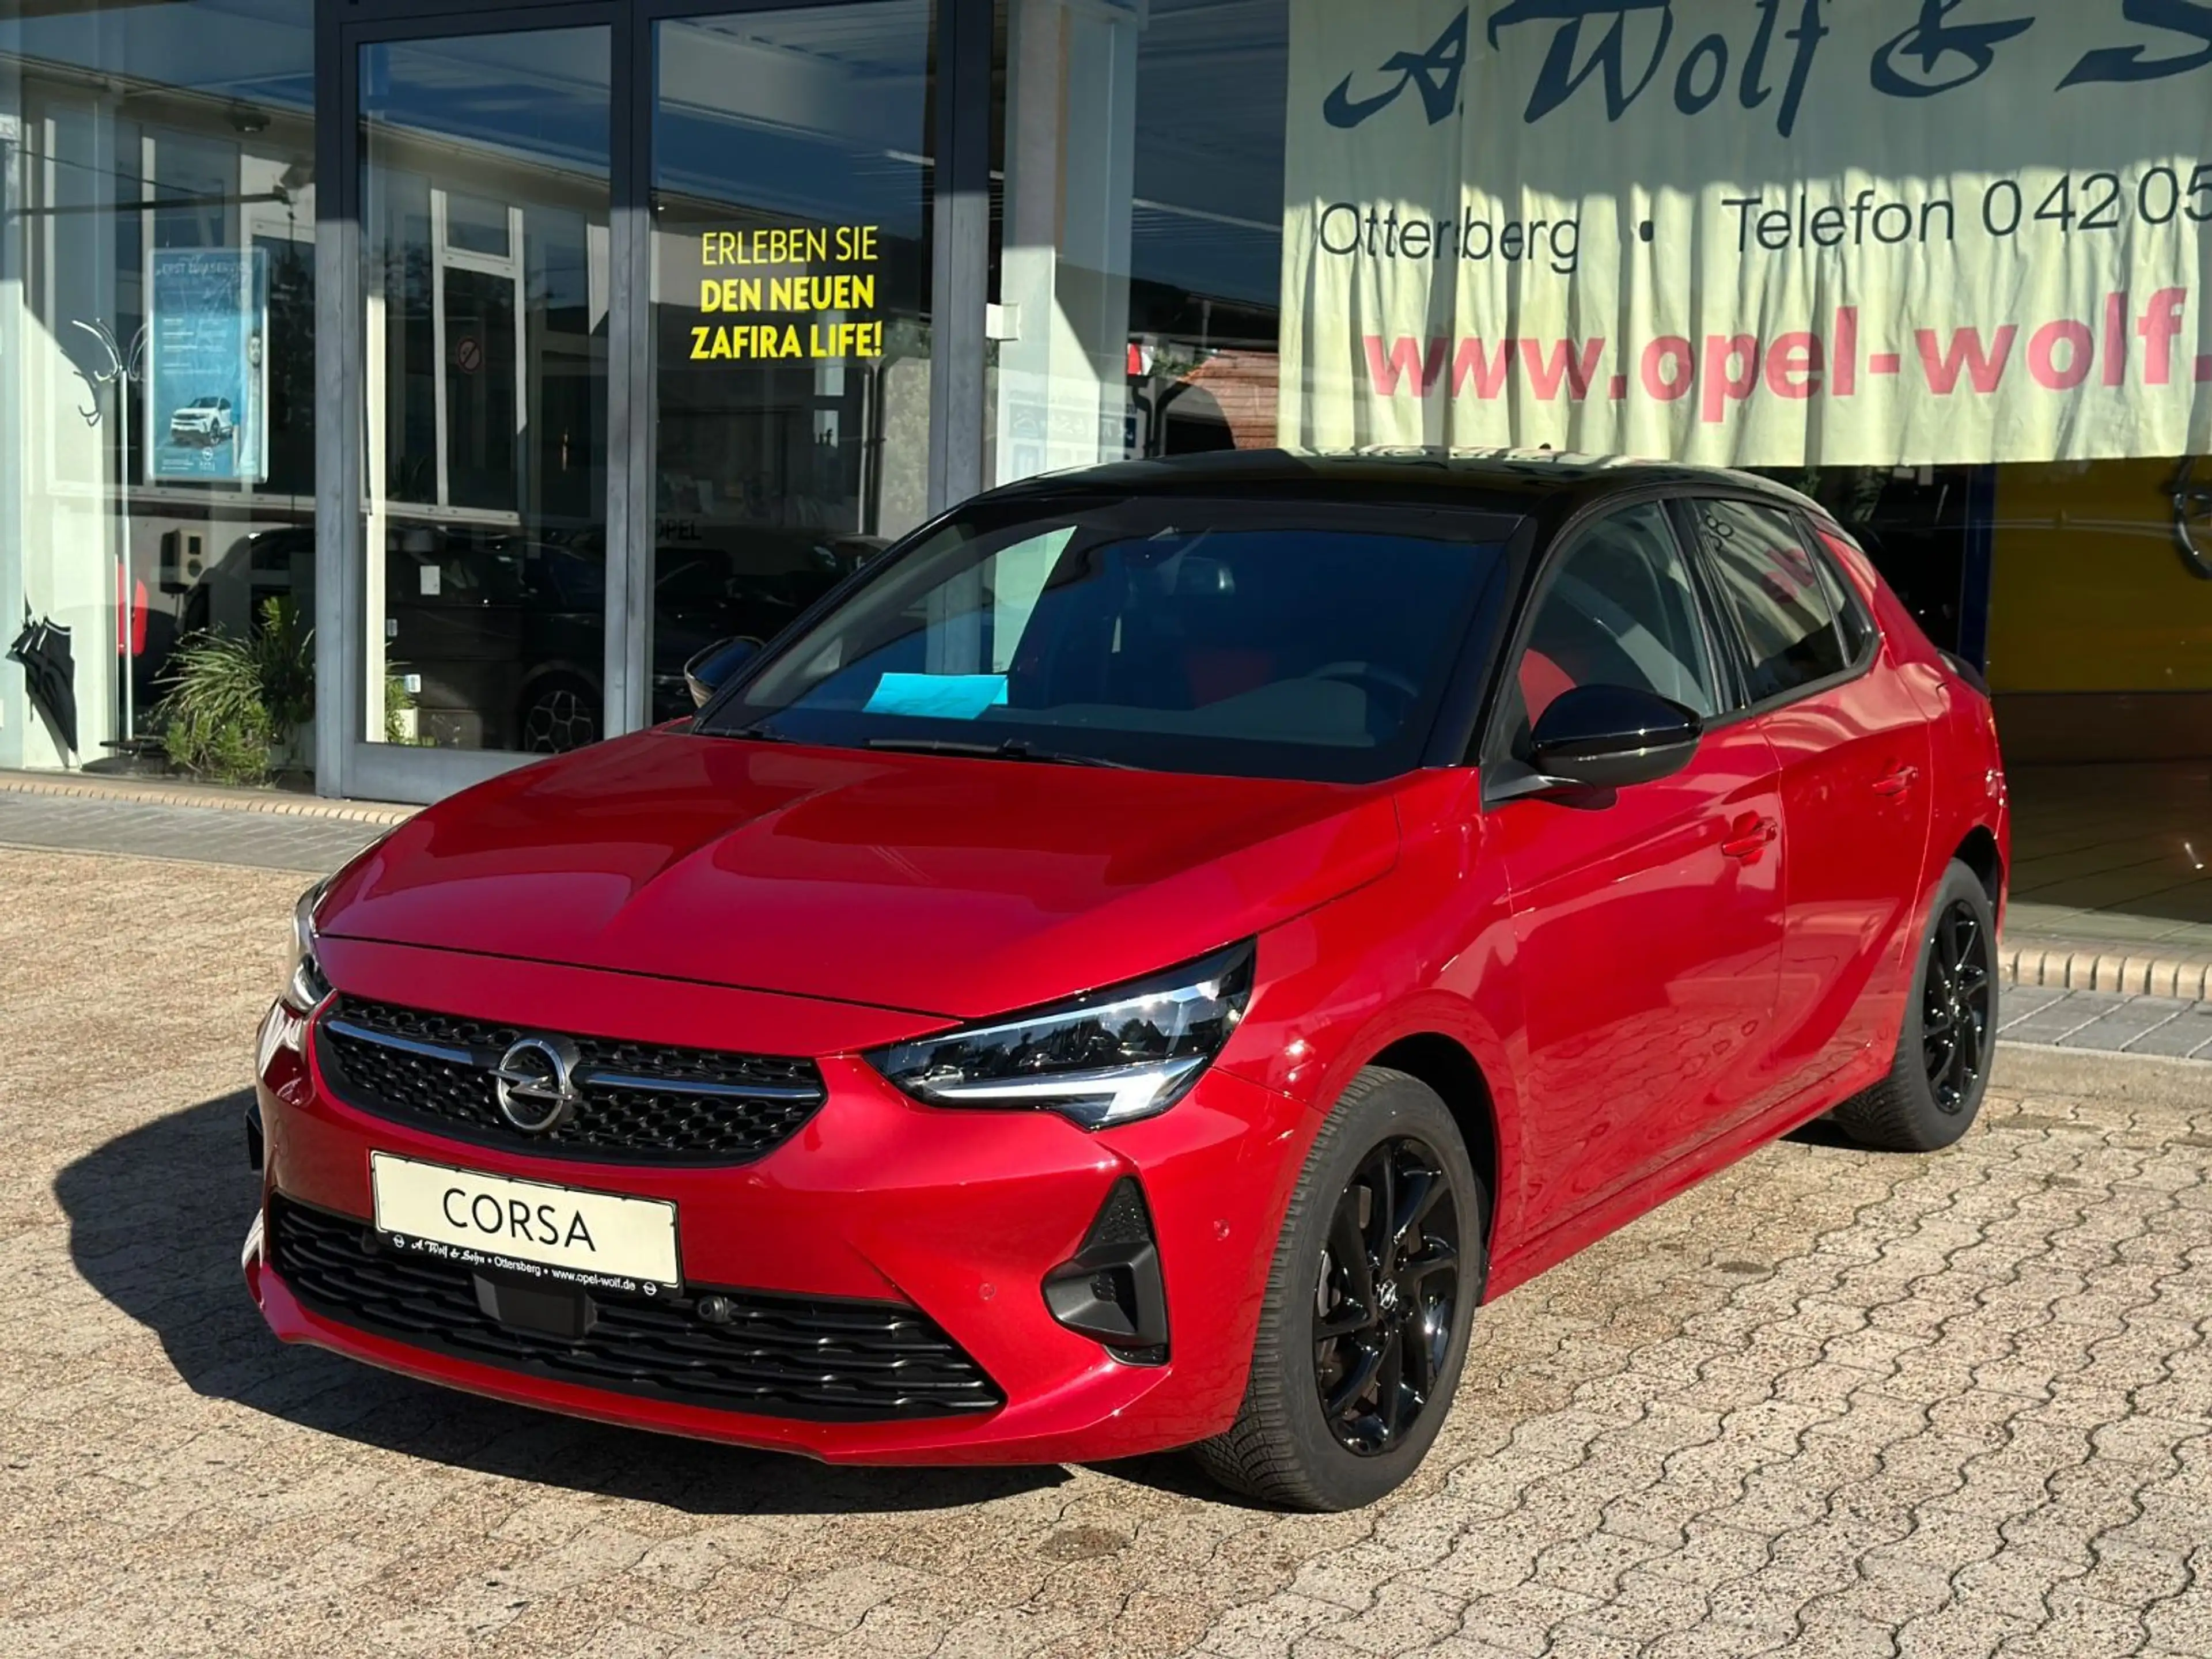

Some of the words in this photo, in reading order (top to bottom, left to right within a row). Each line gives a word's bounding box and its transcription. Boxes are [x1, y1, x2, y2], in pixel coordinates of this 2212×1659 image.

[1487, 0, 1829, 138] Wolf
[1870, 0, 2036, 98] &
[702, 228, 827, 265] ERLEBEN
[836, 225, 879, 262] SIE
[1320, 202, 1580, 274] Otterberg
[1721, 190, 1954, 252] Telefon
[700, 277, 762, 312] DEN
[770, 274, 874, 310] NEUEN
[690, 324, 802, 359] ZAFIRA
[810, 320, 882, 357] LIFE!
[443, 1188, 597, 1253] CORSA
[424, 1240, 448, 1259] Wolf
[449, 1248, 461, 1258] &
[494, 1256, 541, 1278] Ottersberg
[551, 1268, 636, 1291] www.opel-wolf.de
